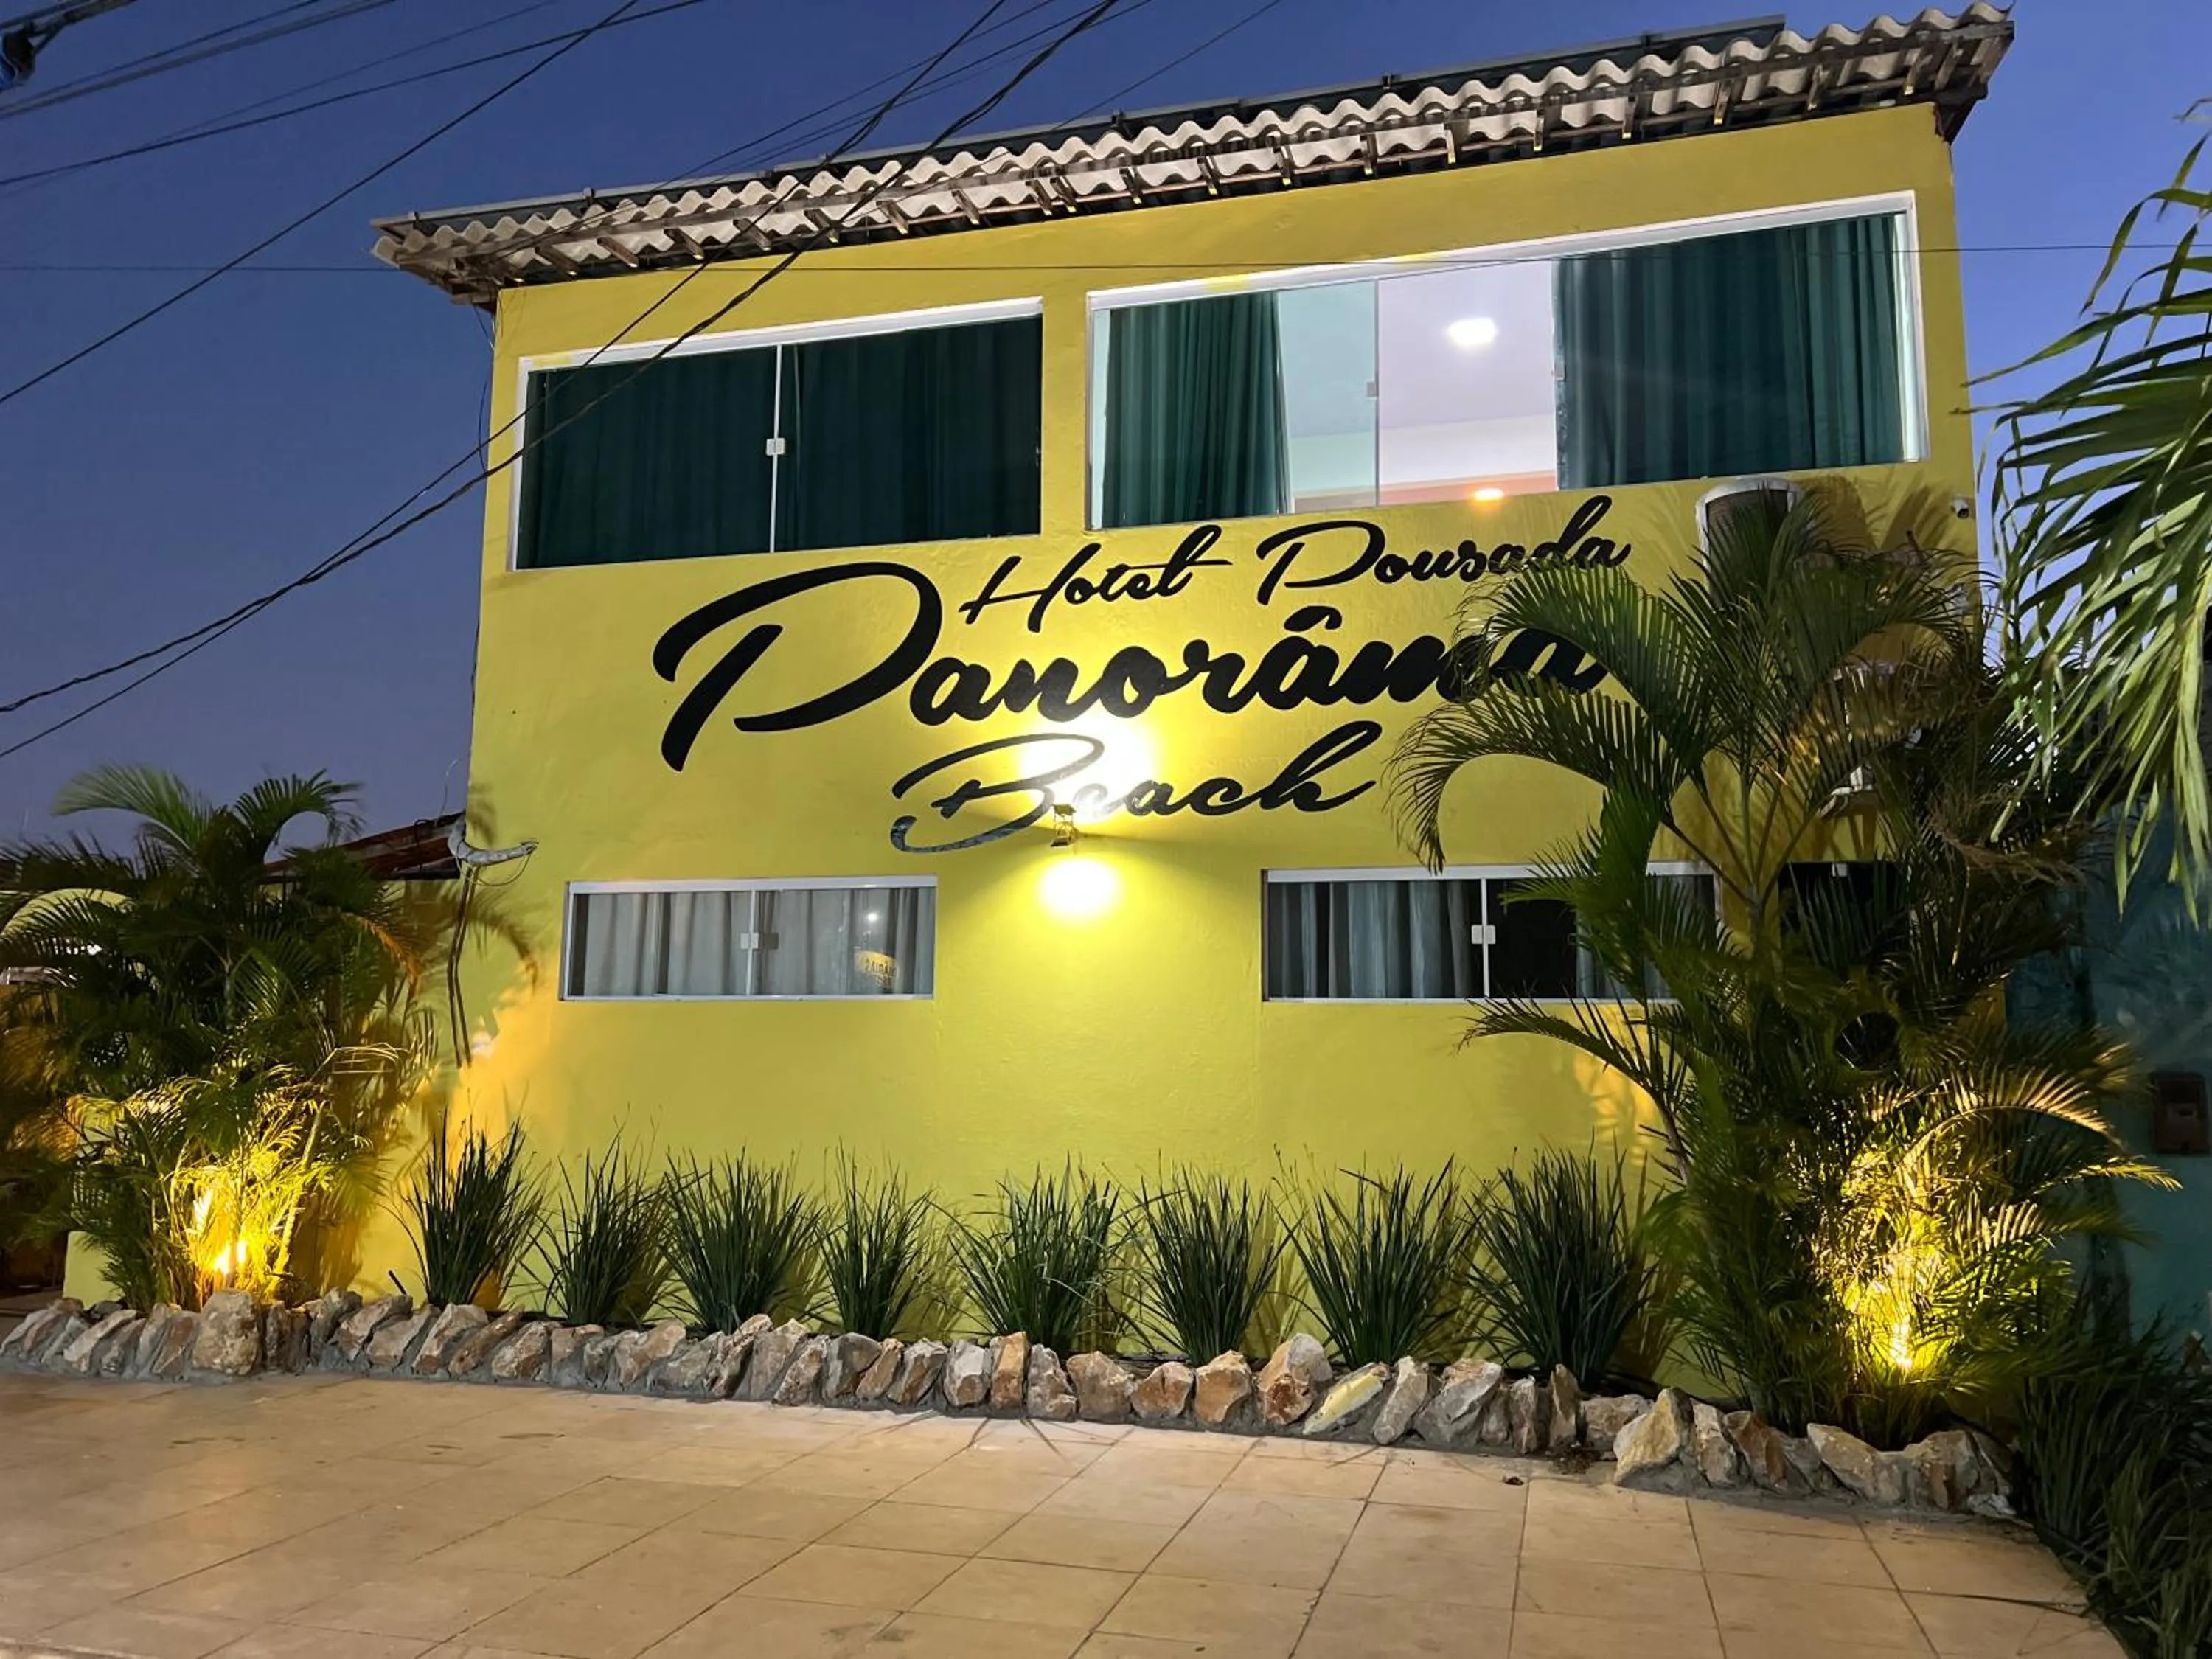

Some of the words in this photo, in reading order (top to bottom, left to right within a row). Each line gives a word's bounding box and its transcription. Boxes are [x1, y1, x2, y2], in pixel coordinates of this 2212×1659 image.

[958, 524, 1233, 632] Hotel
[1256, 495, 1631, 605] Pousada
[890, 720, 1382, 853] Beach
